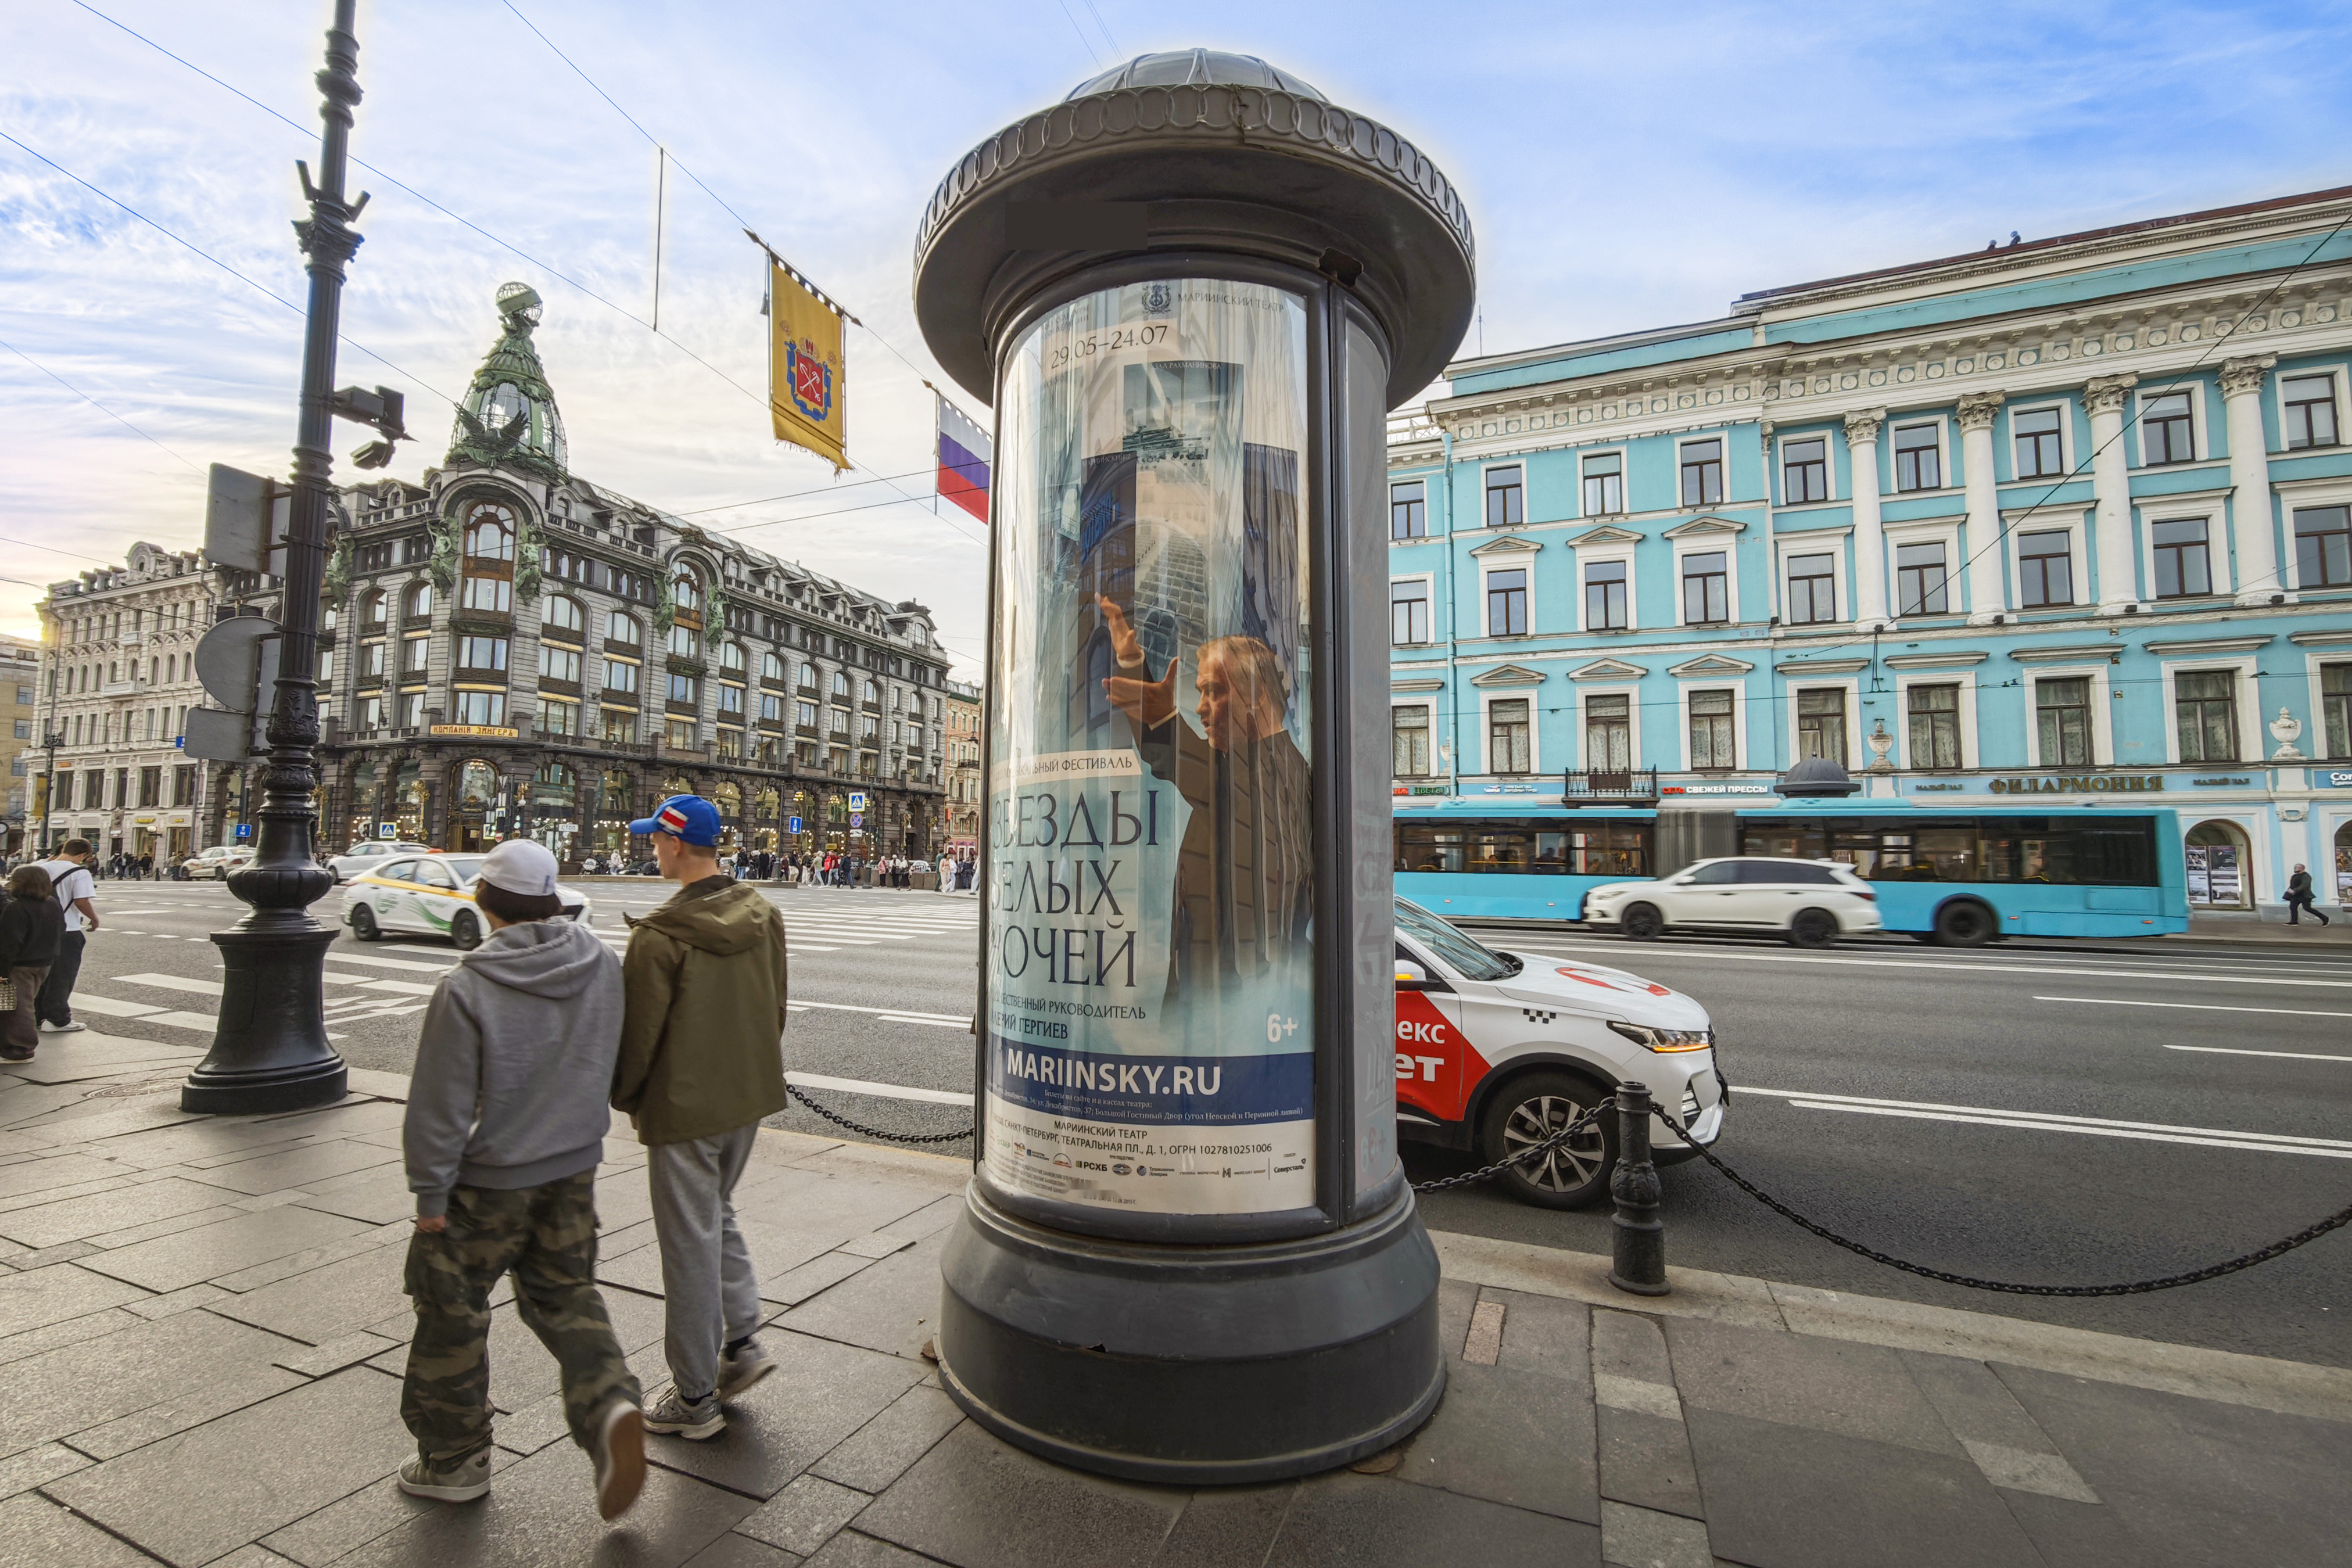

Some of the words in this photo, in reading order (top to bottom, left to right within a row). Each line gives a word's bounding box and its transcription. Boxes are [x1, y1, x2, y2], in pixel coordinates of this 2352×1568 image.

[1178, 292, 1253, 307] МАРИИНСКИЙ
[1255, 297, 1284, 313] ТЕАТР
[1169, 361, 1221, 370] РАХМАНИНОВА
[476, 727, 513, 736] ЗИНГЕРЪ
[1062, 756, 1132, 771] ФЕСТИВАЛЬ
[1686, 784, 1726, 794] СВЕЖЕЙ
[1727, 785, 1768, 794] ПРЕССЫ
[1988, 775, 2164, 794] ФИЛАРМОНИЯ
[993, 790, 1159, 853] ЗВЕЗДЫ
[1049, 1000, 1146, 1020] РУКОВОДИТЕЛЬ
[991, 1011, 1016, 1031] ЛЕРИЙ
[1019, 1017, 1068, 1039] ГЕРГИЕВ
[1267, 1013, 1298, 1043] 6+
[1396, 1020, 1446, 1044] екс
[1007, 1047, 1221, 1096] MARIINSKY.RU
[1045, 1089, 1064, 1099] Билеты
[1073, 1095, 1091, 1103] сайте
[1127, 1101, 1152, 1109] театра:
[1084, 1107, 1094, 1115] 37;
[1095, 1108, 1125, 1118] Большой
[1127, 1111, 1162, 1120] Гостиный
[1163, 1112, 1182, 1122] Двор
[1184, 1112, 1204, 1121] (угол
[1206, 1111, 1236, 1121] Невской
[1245, 1111, 1279, 1120] Перинной
[1281, 1106, 1303, 1116] линий)
[1004, 1119, 1060, 1144] САНКТ-ПЕТЕРБУРГ,
[1061, 1135, 1123, 1152] ТЕАТРАЛЬНАЯ
[1125, 1143, 1144, 1155] ПЛ.,
[1146, 1144, 1156, 1156] Д.
[1159, 1145, 1167, 1156] 1,
[1169, 1144, 1196, 1154] ОГРН
[1200, 1143, 1272, 1154] 1027810251006
[1054, 1120, 1116, 1138] МАРИИНСКИЙ
[1118, 1129, 1148, 1140] ТЕАТР
[1084, 1161, 1107, 1172] РСХБ
[1274, 1164, 1304, 1174] Северсталь
